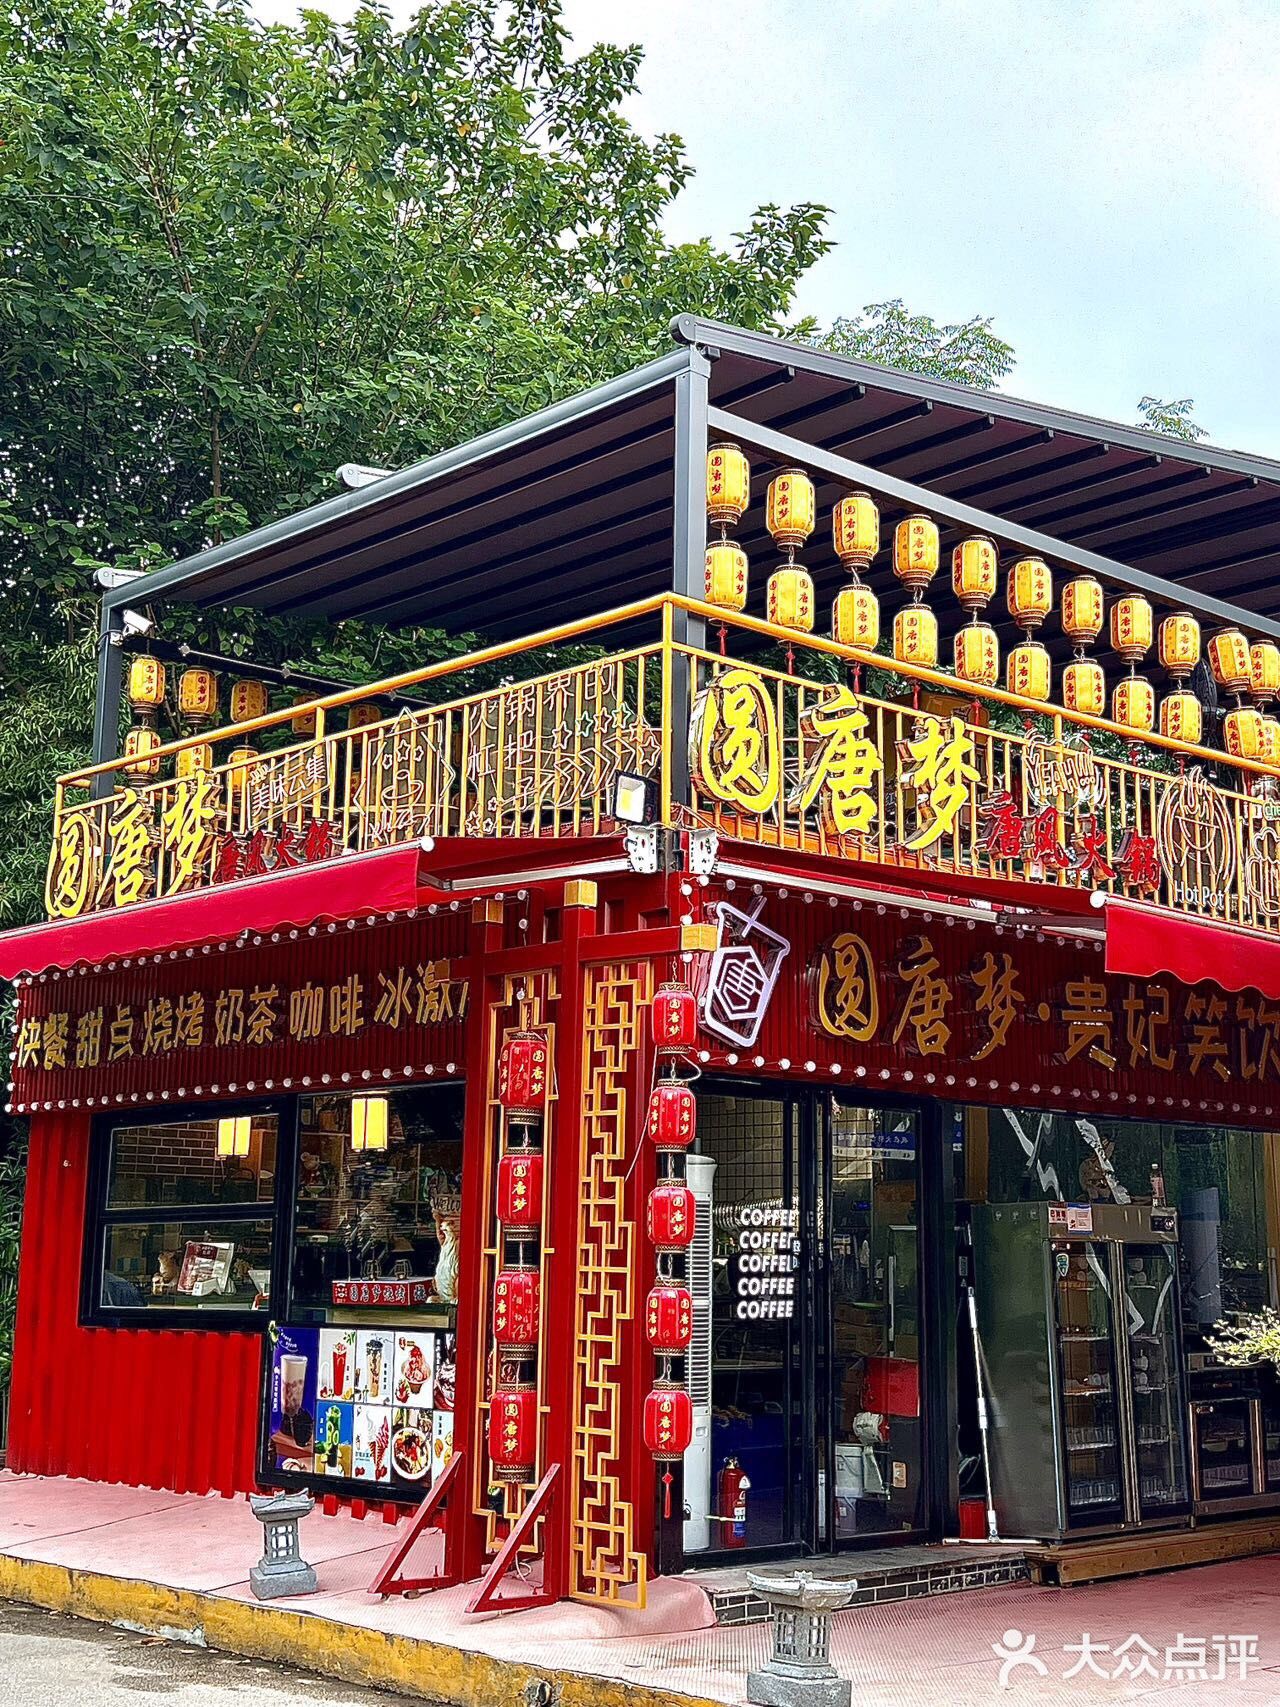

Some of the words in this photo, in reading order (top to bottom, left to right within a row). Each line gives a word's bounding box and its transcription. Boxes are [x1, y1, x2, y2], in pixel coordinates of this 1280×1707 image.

[469, 660, 613, 735] 火锅界的
[252, 752, 326, 817] 美味云集
[699, 669, 981, 850] 圆唐梦
[45, 770, 216, 919] 圆唐梦
[984, 791, 1160, 893] 唐风火锅
[1173, 880, 1200, 905] Hot
[1202, 886, 1225, 909] Pot
[736, 1300, 794, 1319] COFFEE
[738, 1277, 795, 1295] COFFEE
